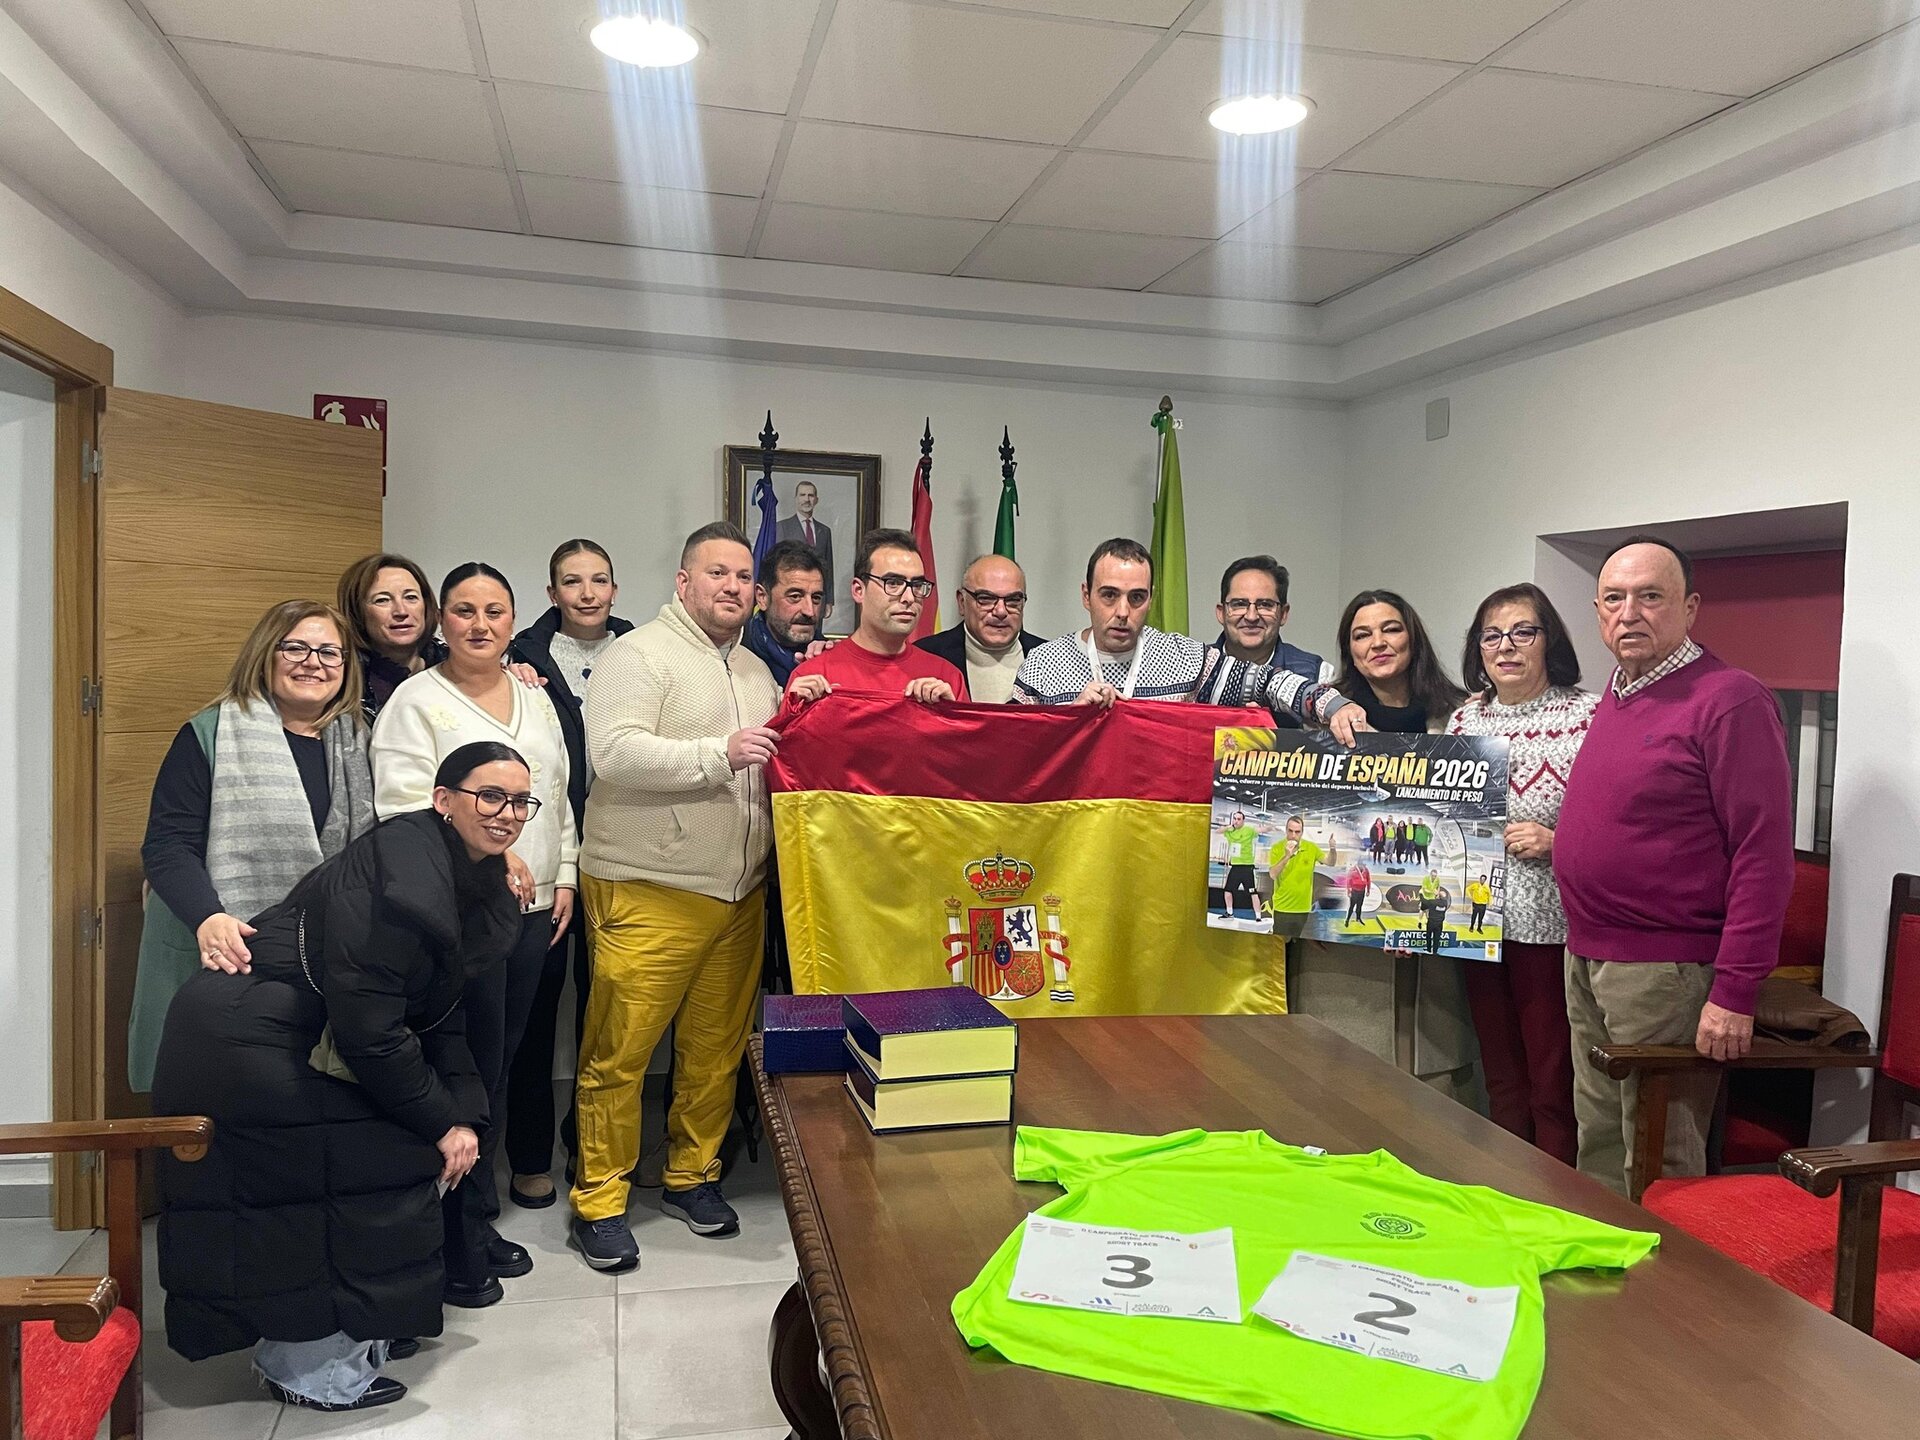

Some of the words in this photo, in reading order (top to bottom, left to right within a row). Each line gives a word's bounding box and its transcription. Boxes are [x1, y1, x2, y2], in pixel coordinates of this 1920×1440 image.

[1220, 745, 1318, 779] CAMPEÓN
[1318, 754, 1347, 781] DE
[1346, 752, 1428, 786] ESPAÑA
[1430, 758, 1490, 789] 2026
[1396, 786, 1450, 800] LANZAMIENTO
[1450, 789, 1461, 801] DE
[1461, 790, 1484, 802] PESO
[1102, 1254, 1154, 1289] 3
[1353, 1291, 1417, 1336] 2
